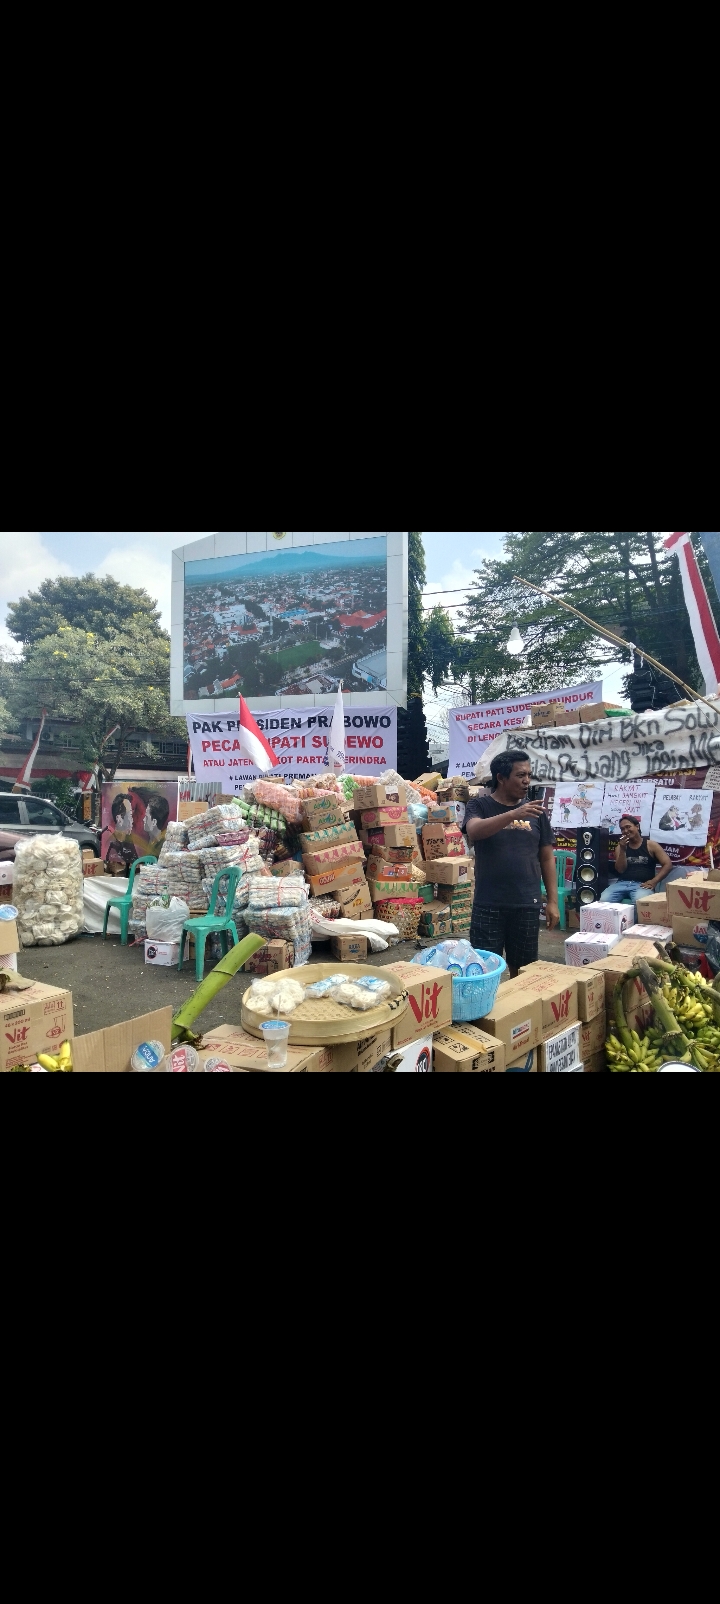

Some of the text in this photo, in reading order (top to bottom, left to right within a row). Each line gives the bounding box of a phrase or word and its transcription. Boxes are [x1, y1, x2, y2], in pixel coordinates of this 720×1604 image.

[455, 711, 484, 721] BUPATI
[485, 707, 505, 718] PATI
[192, 720, 223, 733] PAK
[226, 717, 302, 731] PSIDEN
[467, 720, 502, 732] SECARA
[203, 759, 225, 767] ATAU
[614, 784, 641, 792] RAKYAT
[676, 887, 716, 913] Vit
[640, 911, 651, 919] Vit
[408, 981, 444, 1024] Vit
[550, 989, 573, 1022] Vit
[5, 1026, 30, 1043] Vit
